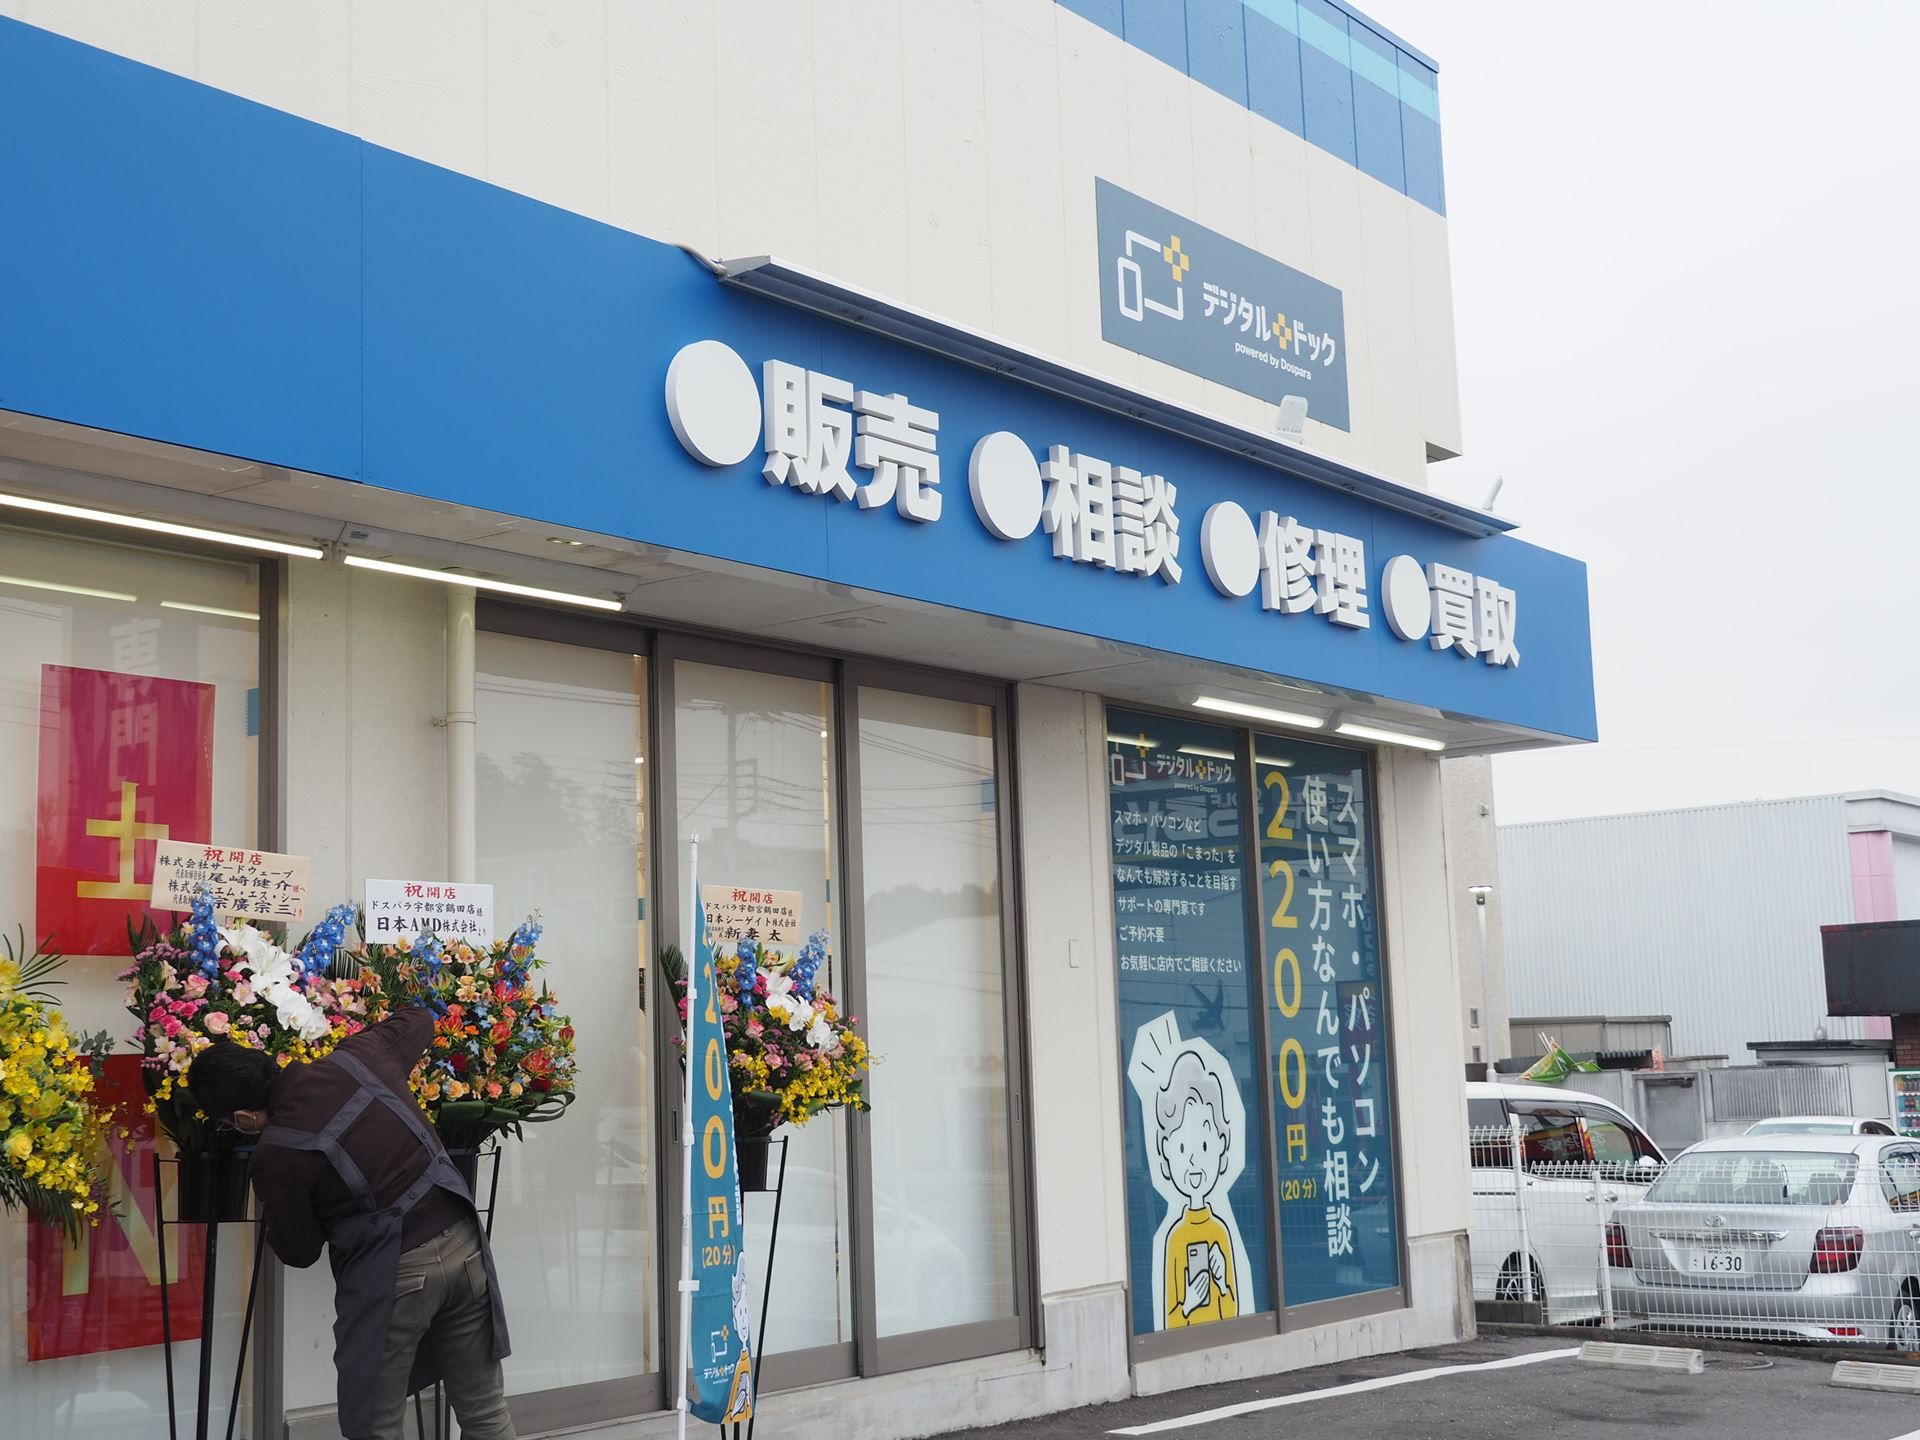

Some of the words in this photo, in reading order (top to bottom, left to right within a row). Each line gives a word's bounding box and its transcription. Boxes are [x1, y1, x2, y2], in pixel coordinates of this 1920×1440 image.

[1235, 341, 1269, 364] powered
[1269, 353, 1280, 369] by
[1280, 357, 1312, 380] Dospara
[1115, 810, 1202, 833] スマホ・パソコンなど
[1116, 867, 1237, 891] なんでも解決することを目指す
[1118, 895, 1206, 916] サポートの専門家です
[1119, 925, 1165, 943] ご予約不要
[1120, 955, 1242, 973] お気軽に店内でご相談ください
[1336, 783, 1380, 1194] スマホ・パソコン
[1301, 774, 1353, 1257] 使い方なんでも相談
